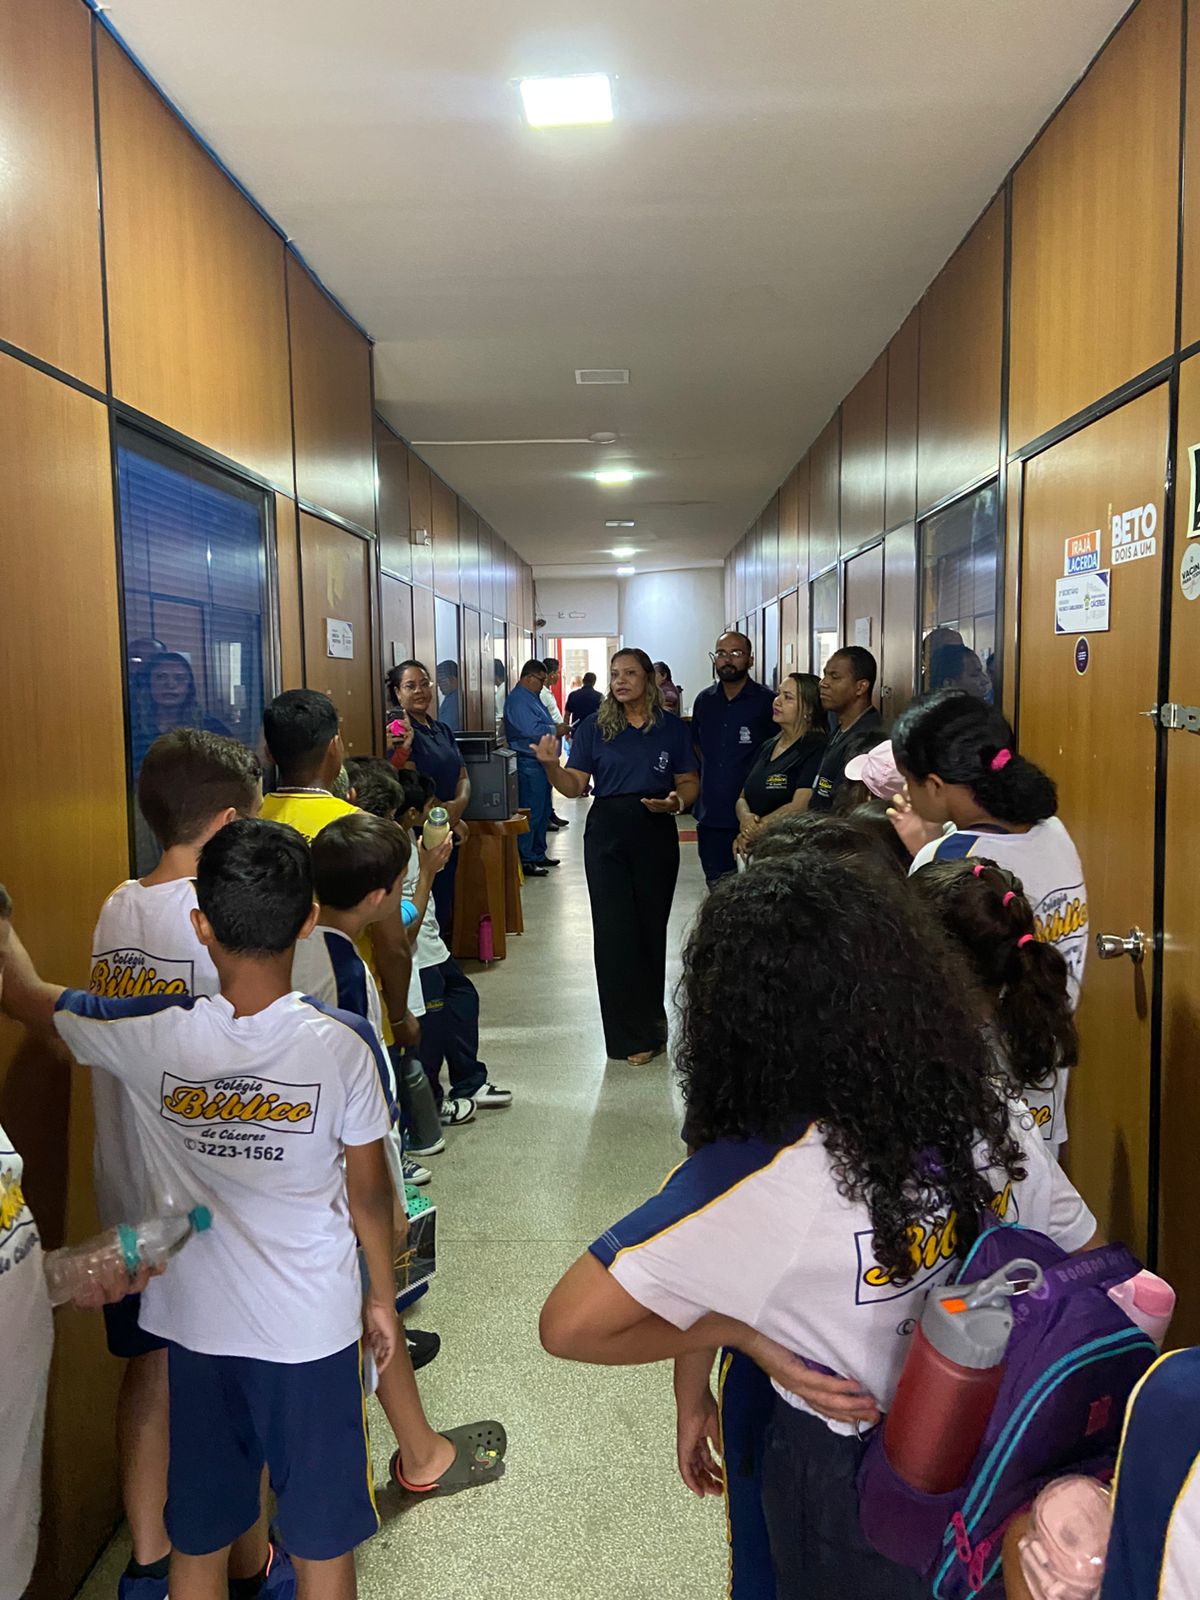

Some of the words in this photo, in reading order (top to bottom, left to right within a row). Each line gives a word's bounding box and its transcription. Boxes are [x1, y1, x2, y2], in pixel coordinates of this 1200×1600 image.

[1112, 503, 1157, 547] BETO
[1071, 535, 1091, 556] IRAJÁ
[1114, 547, 1132, 562] DOIS
[1133, 545, 1138, 558] A
[1140, 541, 1152, 556] UM
[1068, 553, 1098, 573] LACERDA
[113, 952, 145, 968] Colégio
[214, 1079, 263, 1095] Colégio
[163, 1085, 313, 1122] Bíblico
[201, 1128, 215, 1139] de
[219, 1129, 266, 1141] Cáceres
[197, 1141, 284, 1161] 3223-1562
